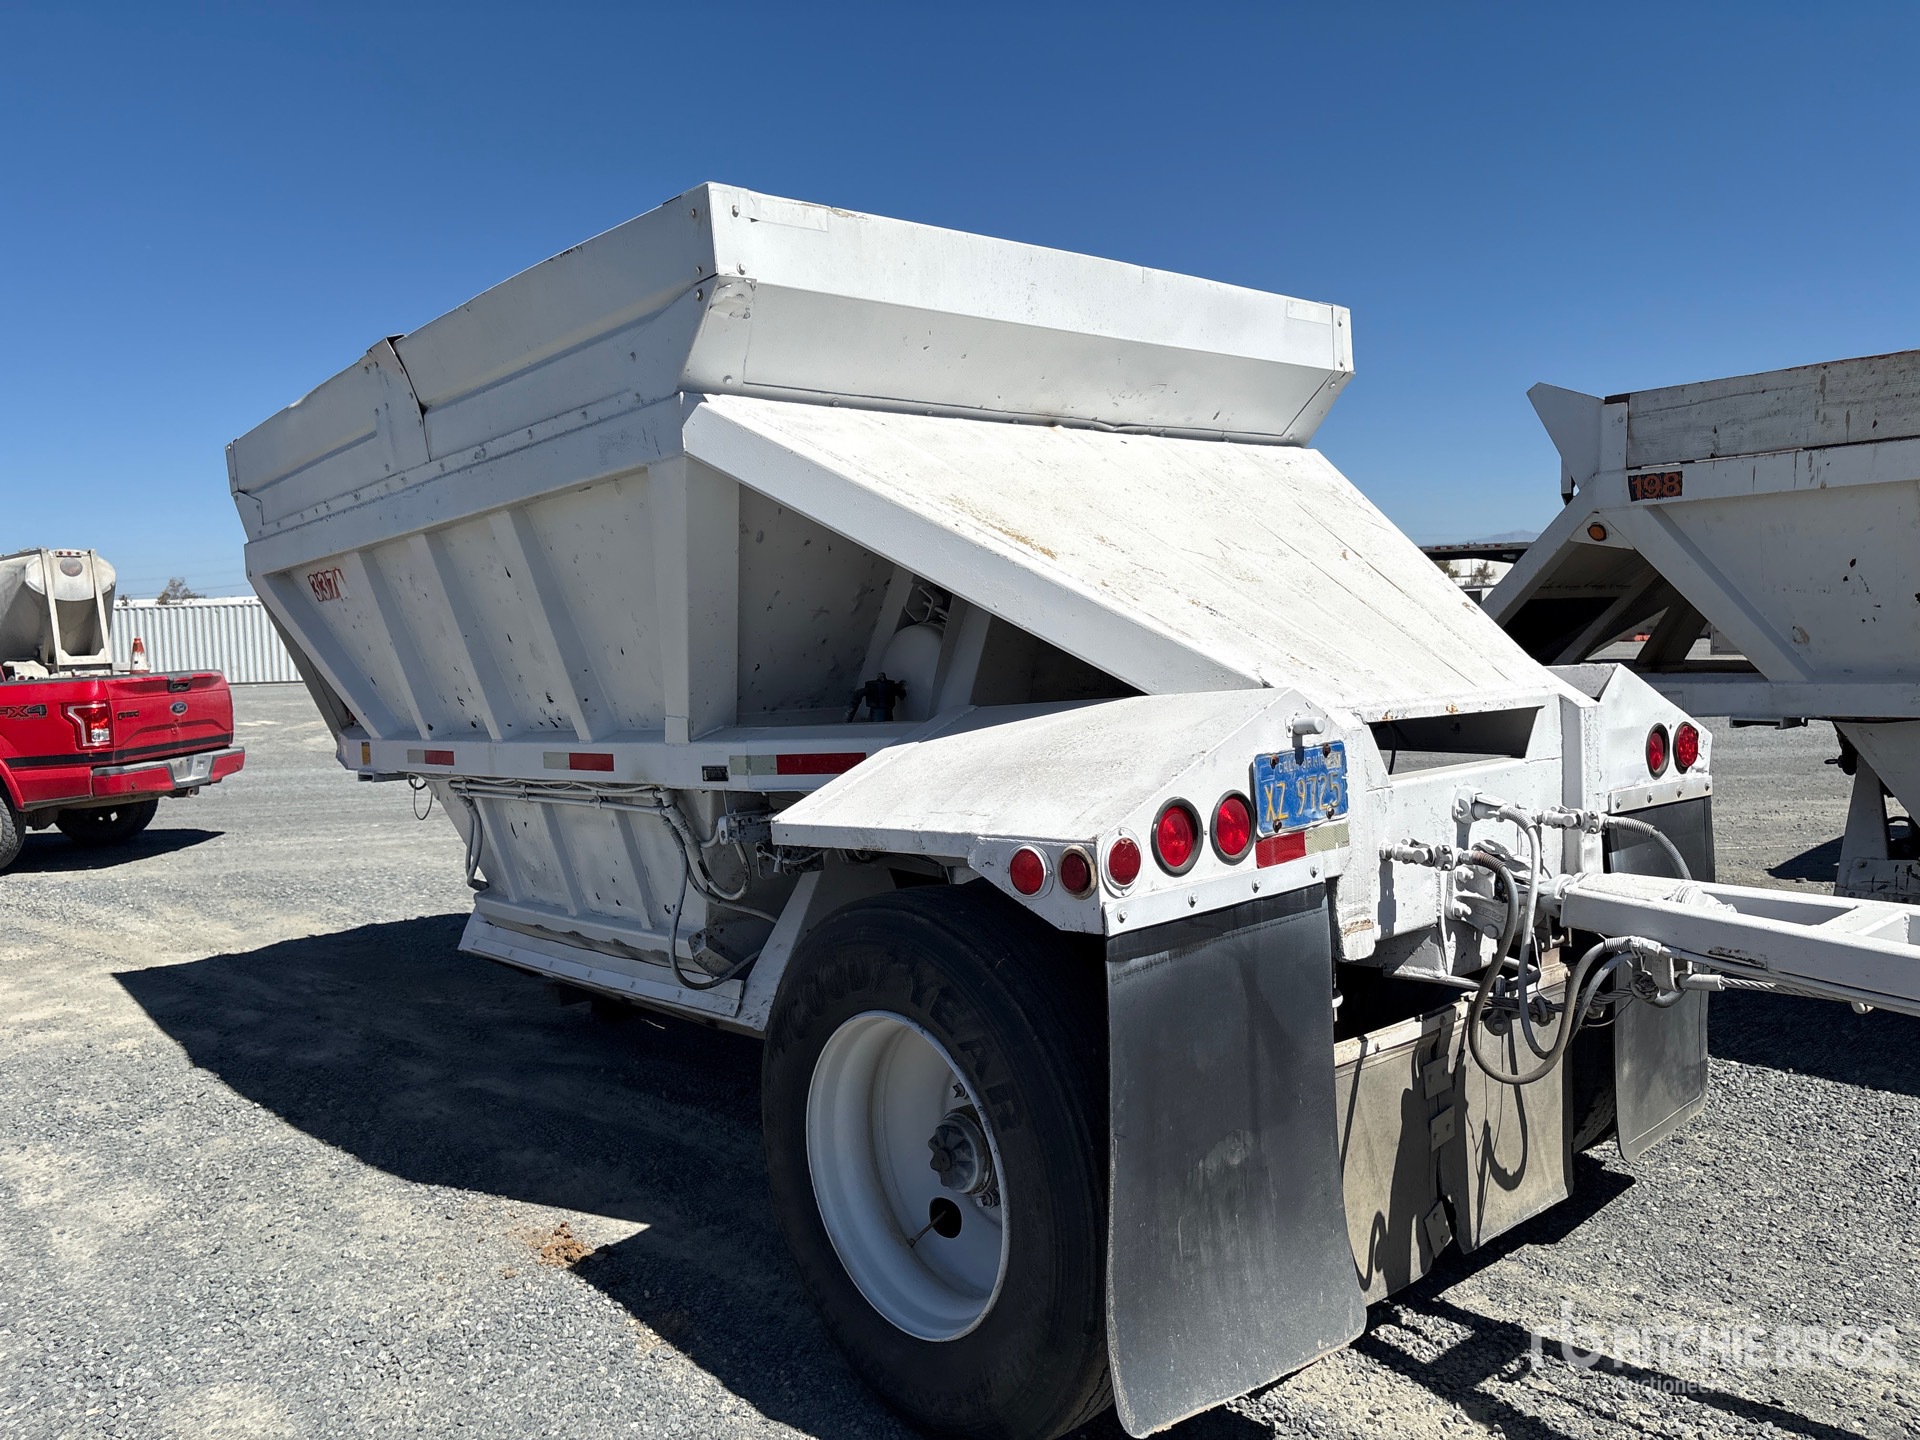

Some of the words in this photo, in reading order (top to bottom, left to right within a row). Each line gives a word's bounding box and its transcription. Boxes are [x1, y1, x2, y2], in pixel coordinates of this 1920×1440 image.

[1632, 473, 1681, 499] 198
[1278, 751, 1326, 773] CALIORNIA
[1264, 782, 1289, 822] XZ
[1296, 770, 1341, 816] 9725
